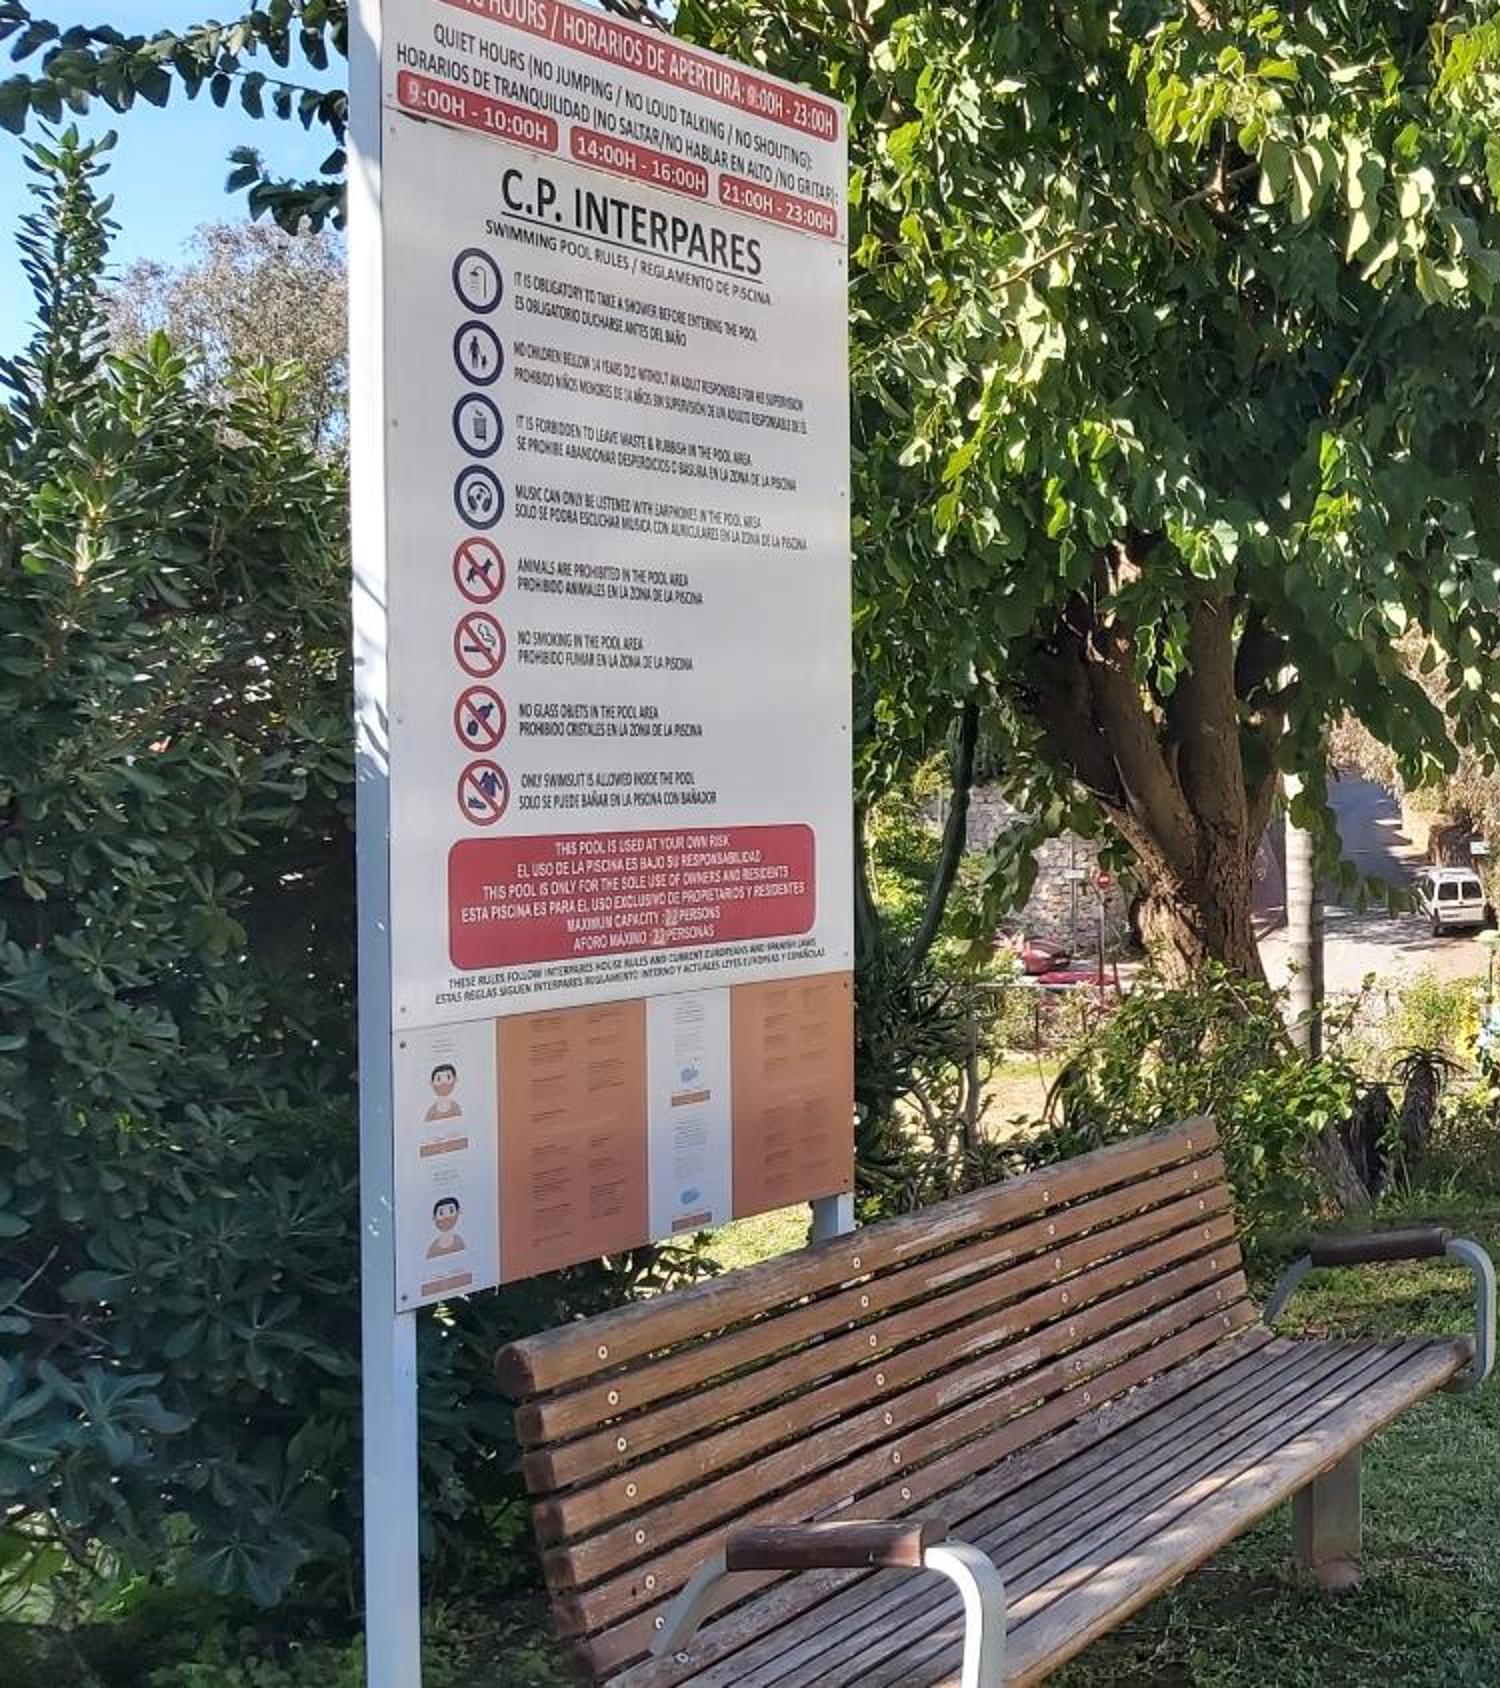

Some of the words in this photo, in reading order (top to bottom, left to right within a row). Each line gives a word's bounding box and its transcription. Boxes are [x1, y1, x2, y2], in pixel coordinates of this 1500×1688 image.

[551, 3, 558, 40] /
[562, 12, 642, 67] HORARIOS
[647, 43, 664, 75] DE
[669, 52, 744, 104] APERTURA:
[793, 98, 832, 135] 23:00H
[408, 81, 465, 118] 9:00H
[484, 105, 547, 143] 10:00H
[433, 22, 475, 56] QUIET
[479, 38, 524, 73] HOURS
[529, 54, 552, 84] (NO
[556, 64, 612, 102] JUMPING
[625, 89, 644, 113] NO
[646, 96, 675, 124] LOUD
[680, 108, 724, 140] TALKING
[736, 127, 751, 149] NO
[754, 134, 812, 170] SHOUTING):
[397, 42, 469, 85] HORARIOS
[473, 67, 491, 93] DE
[494, 74, 589, 124] TRANQUILIDAD
[593, 106, 616, 135] (NO
[619, 116, 682, 154] SALTAR/NO
[685, 138, 730, 170] HABLAR
[731, 153, 744, 174] EN
[747, 159, 772, 184] ALTO
[774, 167, 793, 193] /NO
[577, 134, 636, 171] 14:00H
[651, 158, 705, 192] 16:00H
[501, 165, 561, 223] C.P.
[575, 186, 761, 276] INTERPARES
[722, 181, 772, 213] 21:00H
[786, 201, 832, 232] 23:00H
[485, 218, 557, 252] SWIMMING
[560, 238, 592, 261] POOL
[595, 247, 628, 270] RULES
[641, 259, 713, 291] REGLAMENTO
[716, 278, 729, 295] DE
[732, 283, 770, 306] PISCINA
[517, 557, 554, 575] ANIMALS
[557, 561, 572, 576] ARE
[622, 567, 630, 581] IN
[632, 568, 647, 583] THE
[648, 570, 668, 585] POOL
[669, 572, 688, 586] AREA
[517, 576, 563, 594] PROHIBIDO
[566, 580, 605, 597] ANIMALES
[607, 584, 617, 598] EN
[620, 585, 628, 599] LA
[630, 586, 650, 601] ZONA
[652, 588, 662, 602] DE
[663, 589, 673, 602] LA
[675, 590, 702, 605] PISCINA
[518, 630, 530, 645] NO
[533, 631, 571, 647] SMOKING
[574, 633, 582, 647] IN
[584, 634, 599, 648] THE
[601, 635, 622, 649] POOL
[623, 636, 642, 651] AREA
[519, 703, 531, 717] NO
[534, 703, 558, 718] GLASS
[590, 705, 598, 718] IN
[601, 705, 615, 718] THE
[617, 705, 638, 719] POOL
[640, 706, 658, 719] AREA
[519, 721, 564, 736] PROHIBIDO
[566, 722, 604, 736] CRISTALES
[607, 722, 617, 736] EN
[619, 723, 628, 736] LA
[630, 723, 650, 736] ZONA
[652, 723, 662, 737] DE
[663, 723, 672, 737] LA
[674, 723, 702, 737] PISCINA
[521, 773, 541, 788] ONLY
[544, 773, 584, 787] SWIMSUIT
[586, 773, 594, 786] IS
[596, 772, 632, 786] ALLOWED
[634, 772, 658, 786] INSIDE
[659, 772, 673, 785] THE
[675, 772, 694, 785] POOL
[519, 795, 539, 809] SOLO
[542, 794, 552, 808] SE
[554, 794, 580, 808] PUEDE
[581, 790, 608, 807] BAÑAR
[610, 793, 620, 806] EN
[622, 792, 631, 806] LA
[633, 792, 662, 806] PISCINA
[663, 791, 678, 805] CON
[681, 788, 716, 804] BAÑADOR
[555, 841, 576, 856] THIS
[579, 840, 607, 854] POOL
[607, 839, 616, 853] IS
[618, 838, 644, 852] USED
[646, 837, 658, 851] AT
[659, 836, 683, 850] YOUR
[685, 835, 707, 848] OWN
[709, 834, 729, 847] RISK
[516, 863, 530, 878] EL
[533, 861, 553, 877] USO
[556, 860, 569, 875] DE
[571, 860, 583, 874] LA
[583, 857, 624, 873] PISCINA
[625, 856, 637, 871] ES
[639, 855, 664, 870] BAJO
[667, 854, 678, 868] SU
[681, 849, 762, 867] RESPONSABILIDAD
[482, 884, 506, 900] THIS
[509, 882, 536, 898] POOL
[539, 881, 548, 896] IS
[550, 879, 577, 895] ONLY
[579, 878, 598, 893] FOR
[601, 877, 618, 891] THE
[621, 875, 646, 890] SOLE
[648, 873, 667, 888] USE
[669, 872, 680, 886] OF
[683, 870, 721, 885] OWNERS
[723, 868, 740, 882] AND
[742, 865, 789, 881] RESIDENTS
[461, 906, 488, 923] ESTA
[491, 902, 531, 920] PISCINA
[533, 901, 546, 916] ES
[549, 899, 576, 915] PARA
[578, 898, 589, 913] EL
[591, 896, 612, 912] USO
[614, 892, 665, 910] EXCLUSIVO
[668, 891, 680, 905] DE
[747, 885, 752, 898] Y
[753, 881, 804, 898] RESIDENTES
